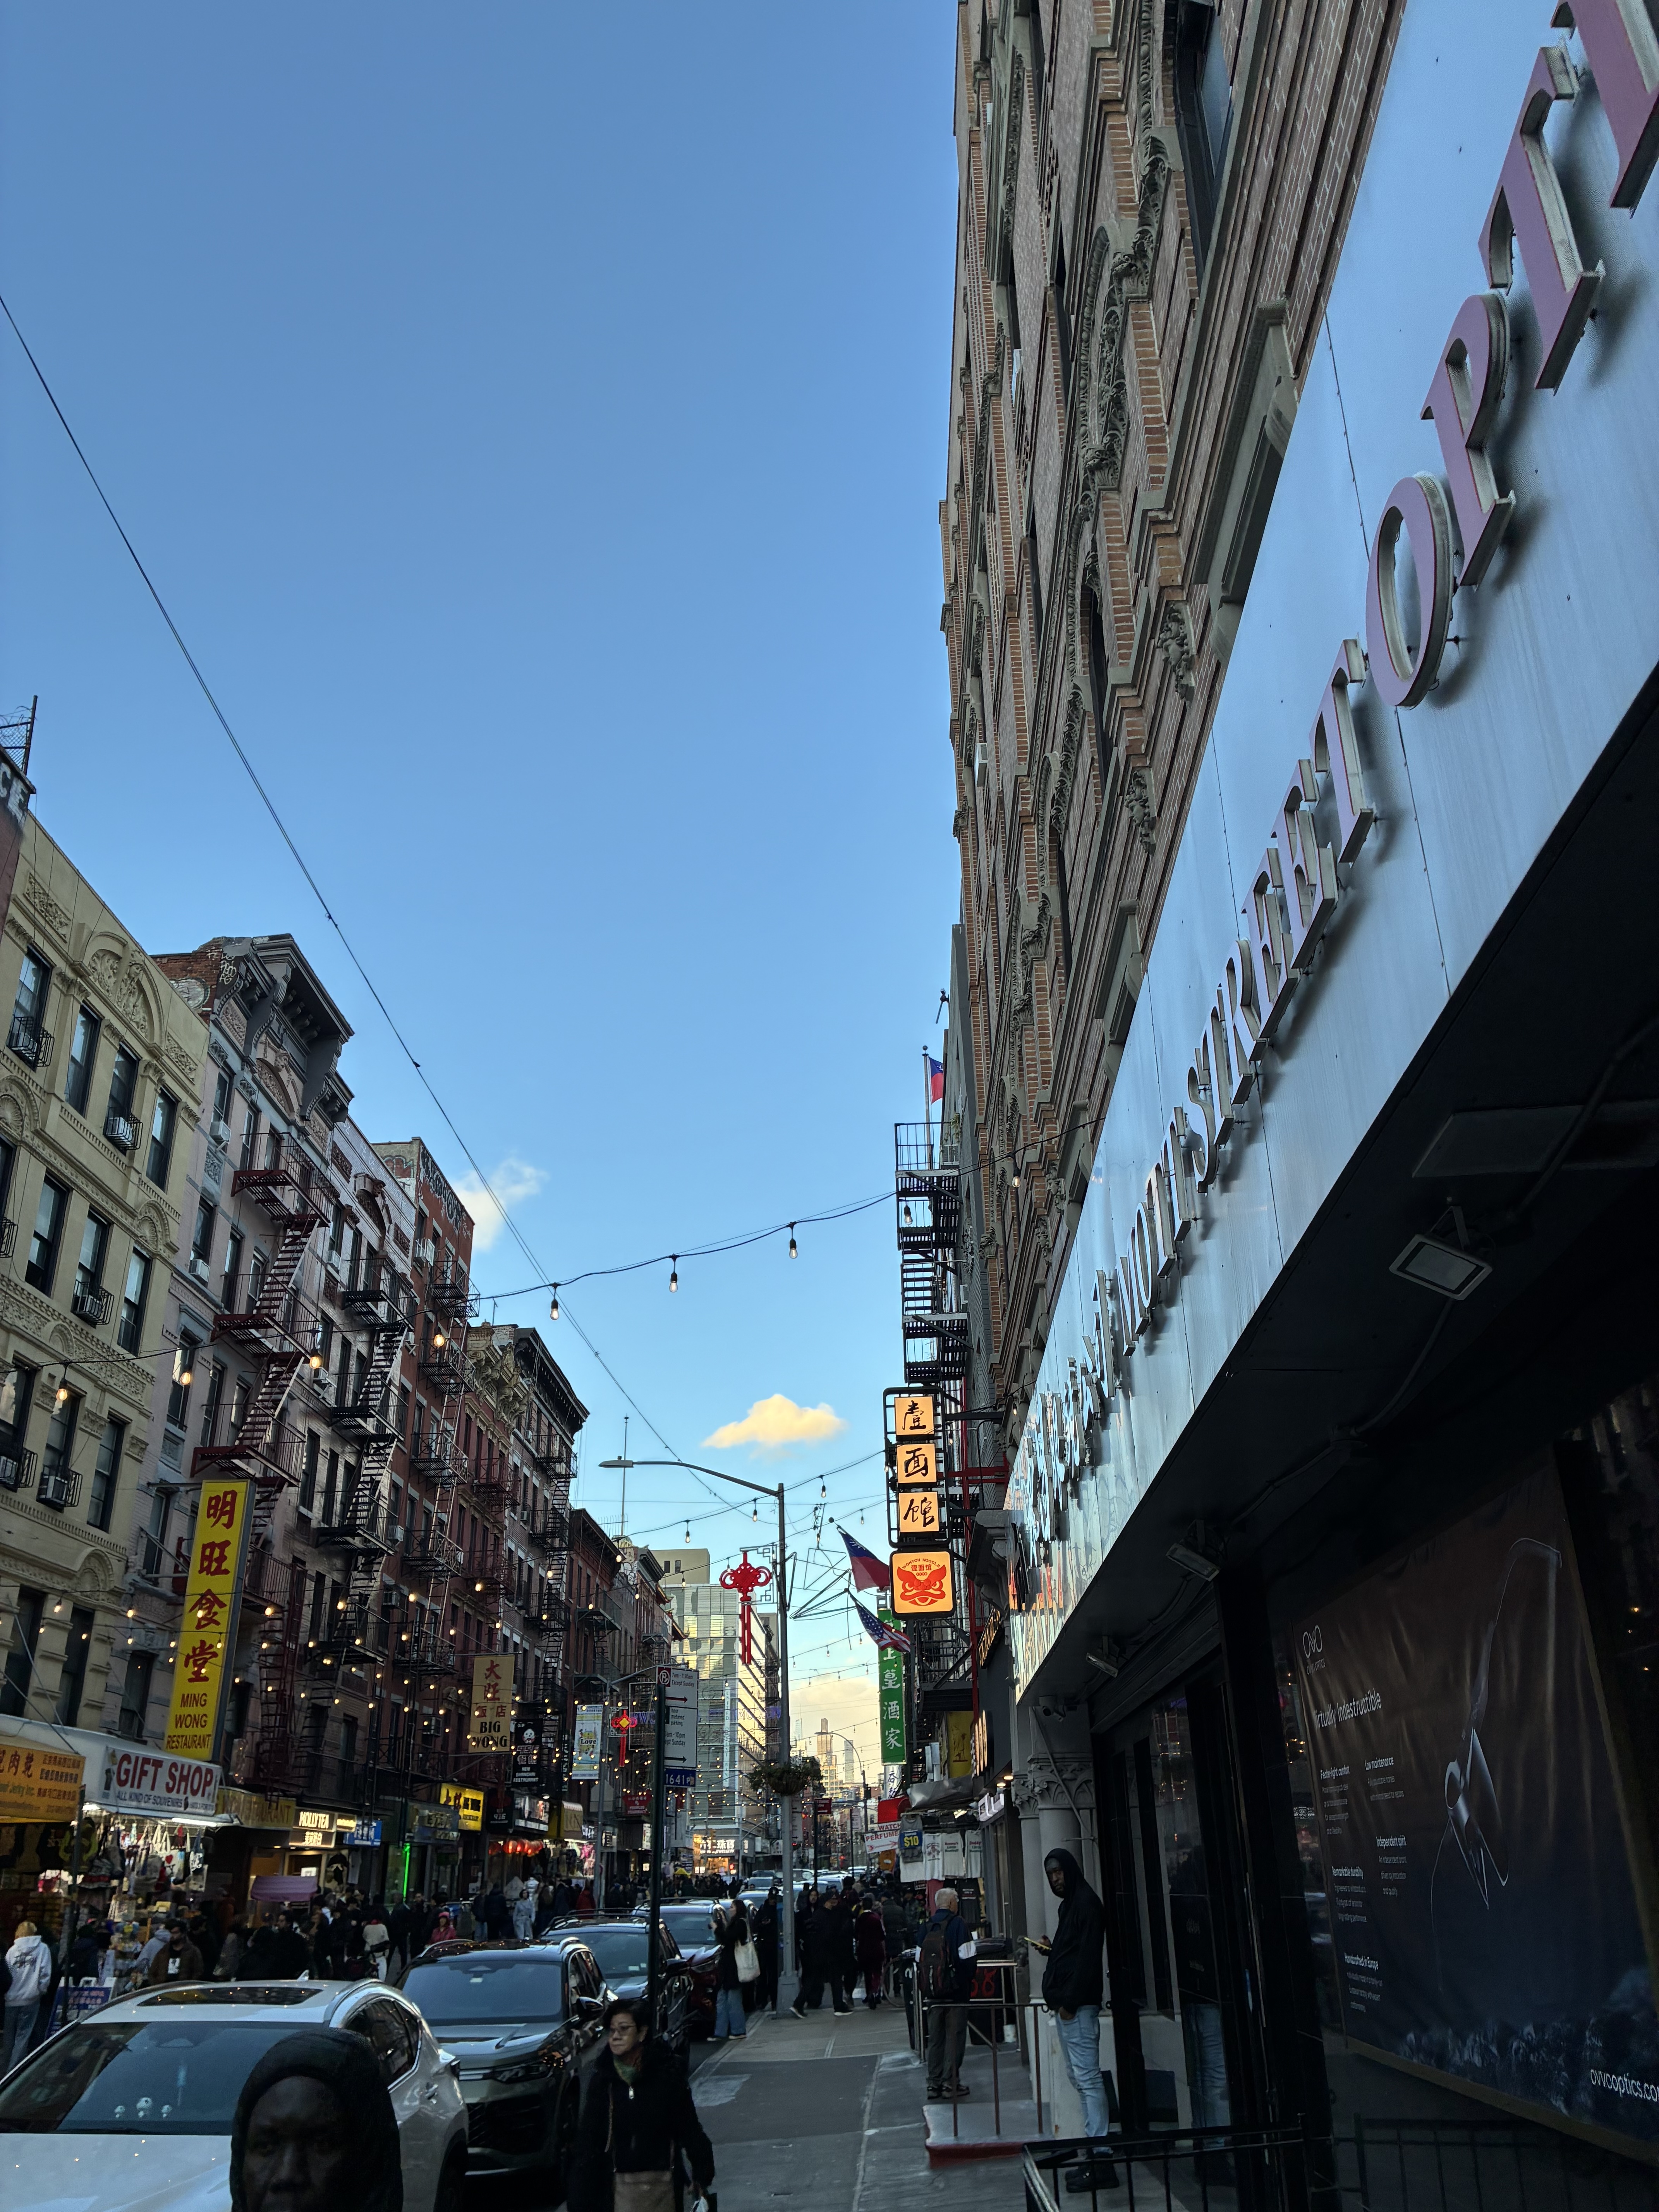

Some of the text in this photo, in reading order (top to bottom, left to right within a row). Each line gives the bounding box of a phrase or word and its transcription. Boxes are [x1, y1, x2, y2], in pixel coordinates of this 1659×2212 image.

[1115, 1106, 1193, 1356] MOTT
[1187, 637, 1375, 1194] STREET
[902, 1558, 921, 1569] WONTON
[184, 1489, 238, 1683] 明旺食堂
[483, 1659, 502, 1702] 大旺
[881, 1620, 903, 1750] 上皇酒家
[180, 1692, 208, 1709] MING
[1336, 1688, 1382, 1723] Indestructible
[174, 1713, 208, 1729] WONG
[480, 1721, 501, 1733] BIG
[166, 1734, 212, 1750] RESTAURANT
[472, 1735, 508, 1748] WONG
[672, 1739, 686, 1748] Sunday
[116, 1753, 164, 1791] GIFT
[144, 1794, 153, 1804] OF
[299, 1811, 318, 1828] MOLLY
[318, 1813, 329, 1829] TEA
[903, 1835, 919, 1848] $10
[1590, 2069, 1659, 2102] ovvooptics.co
